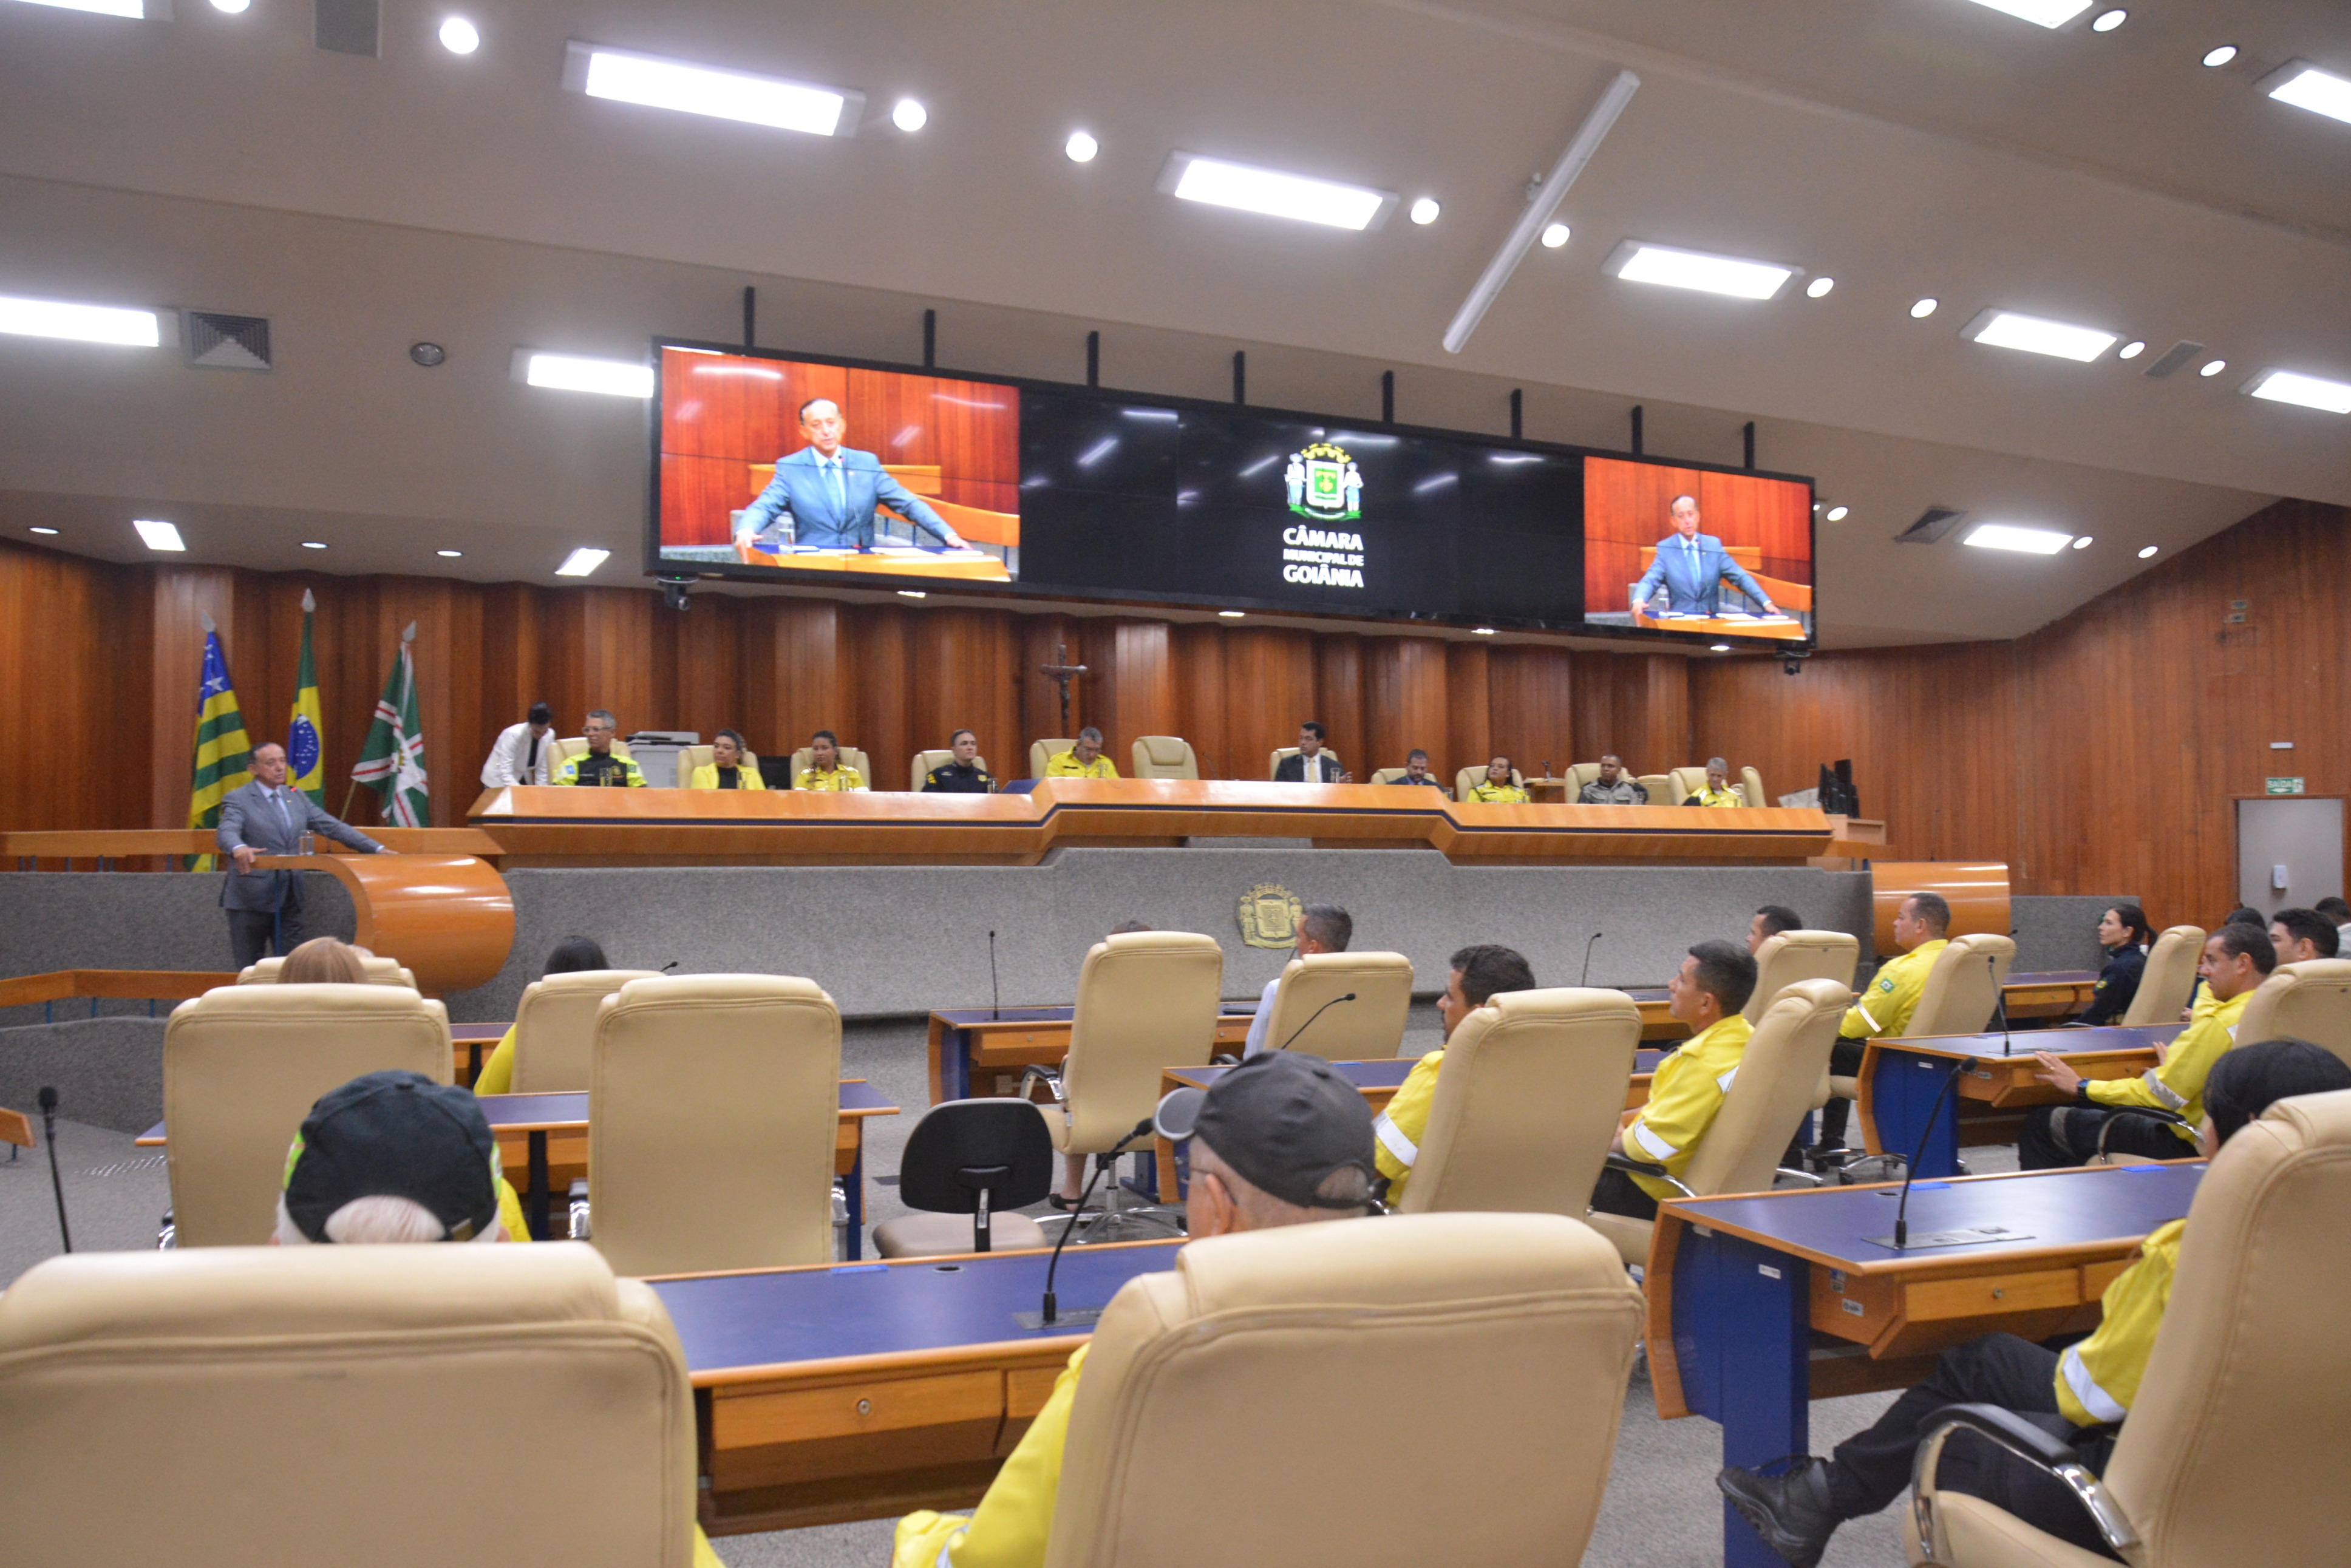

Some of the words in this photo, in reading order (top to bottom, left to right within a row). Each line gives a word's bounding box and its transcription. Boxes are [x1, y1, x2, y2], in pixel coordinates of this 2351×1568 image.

[1283, 524, 1364, 551] CÂMARA
[1283, 548, 1347, 565] MUNICIPAL
[1347, 554, 1364, 566] DE
[1283, 563, 1364, 588] GOIÂNIA
